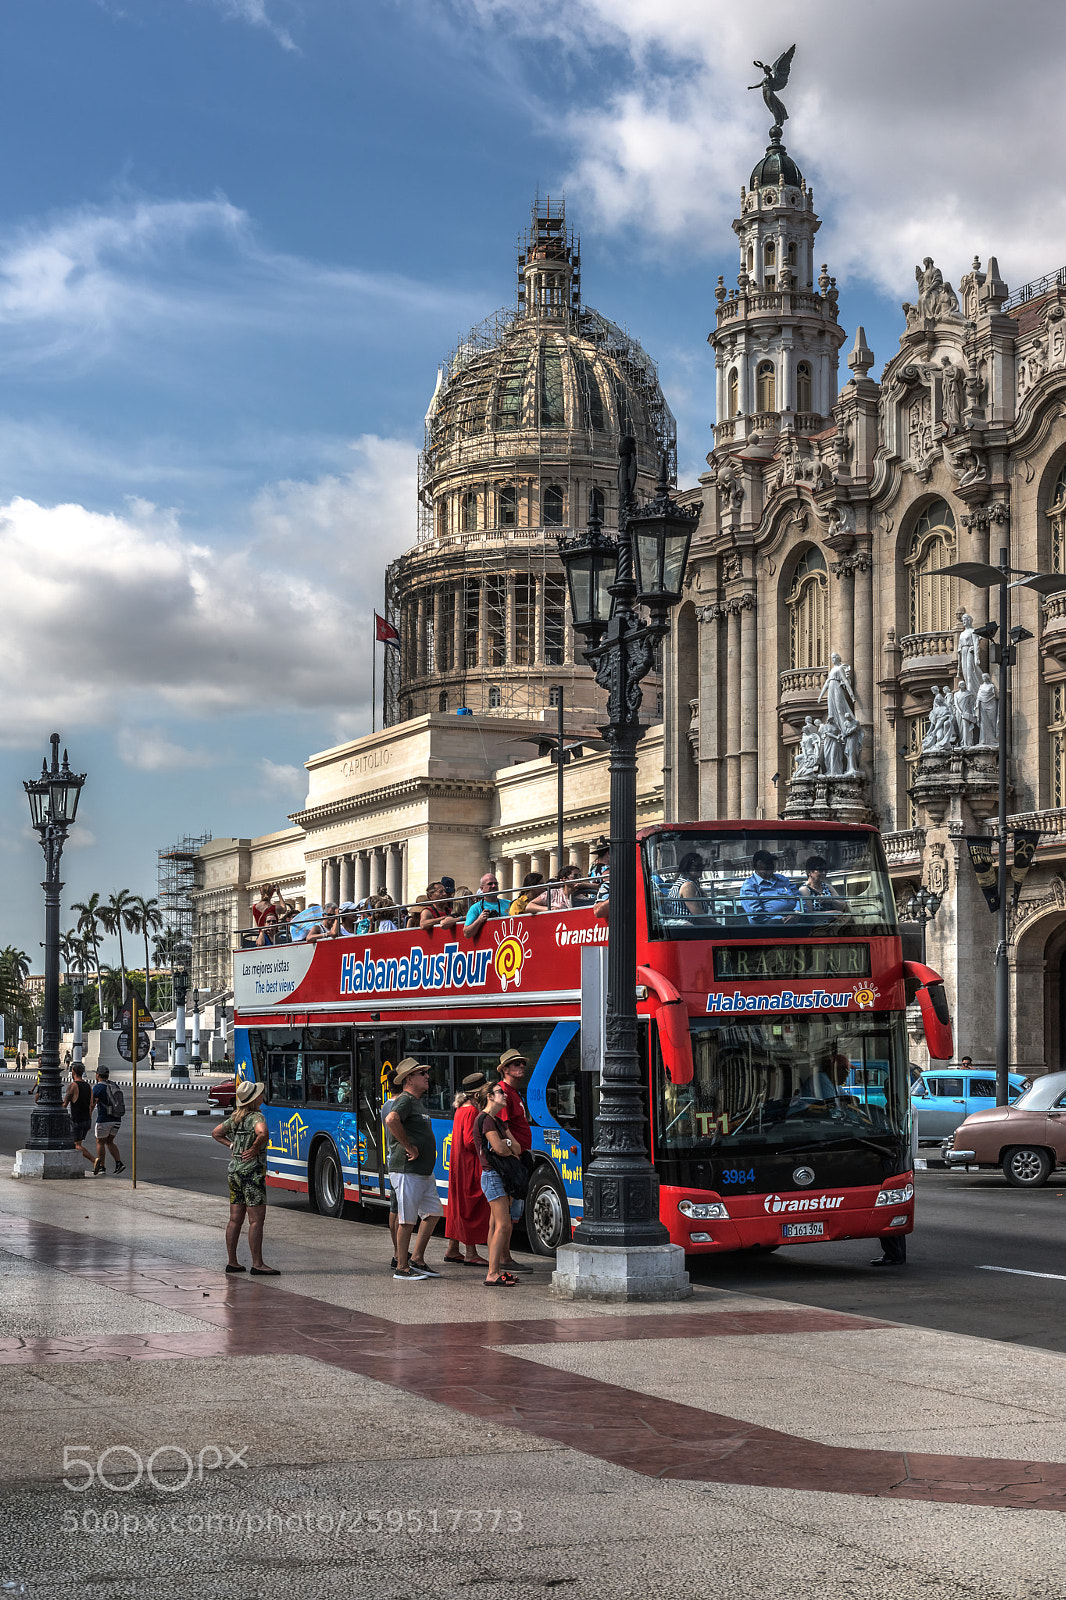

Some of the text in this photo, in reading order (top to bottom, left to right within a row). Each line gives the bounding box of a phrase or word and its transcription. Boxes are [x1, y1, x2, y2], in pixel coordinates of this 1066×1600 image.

[342, 749, 390, 777] CAPITOLIO
[242, 959, 290, 977] Las mejores vistas
[340, 942, 493, 994] HabanaBusTour
[718, 949, 862, 974] TRANSTUR
[255, 978, 295, 993] The best views
[706, 990, 852, 1012] HabanaBusTour
[695, 1112, 730, 1136] T-1
[551, 1144, 569, 1163] Hop on
[561, 1163, 582, 1184] Hop off
[722, 1168, 756, 1184] 3984
